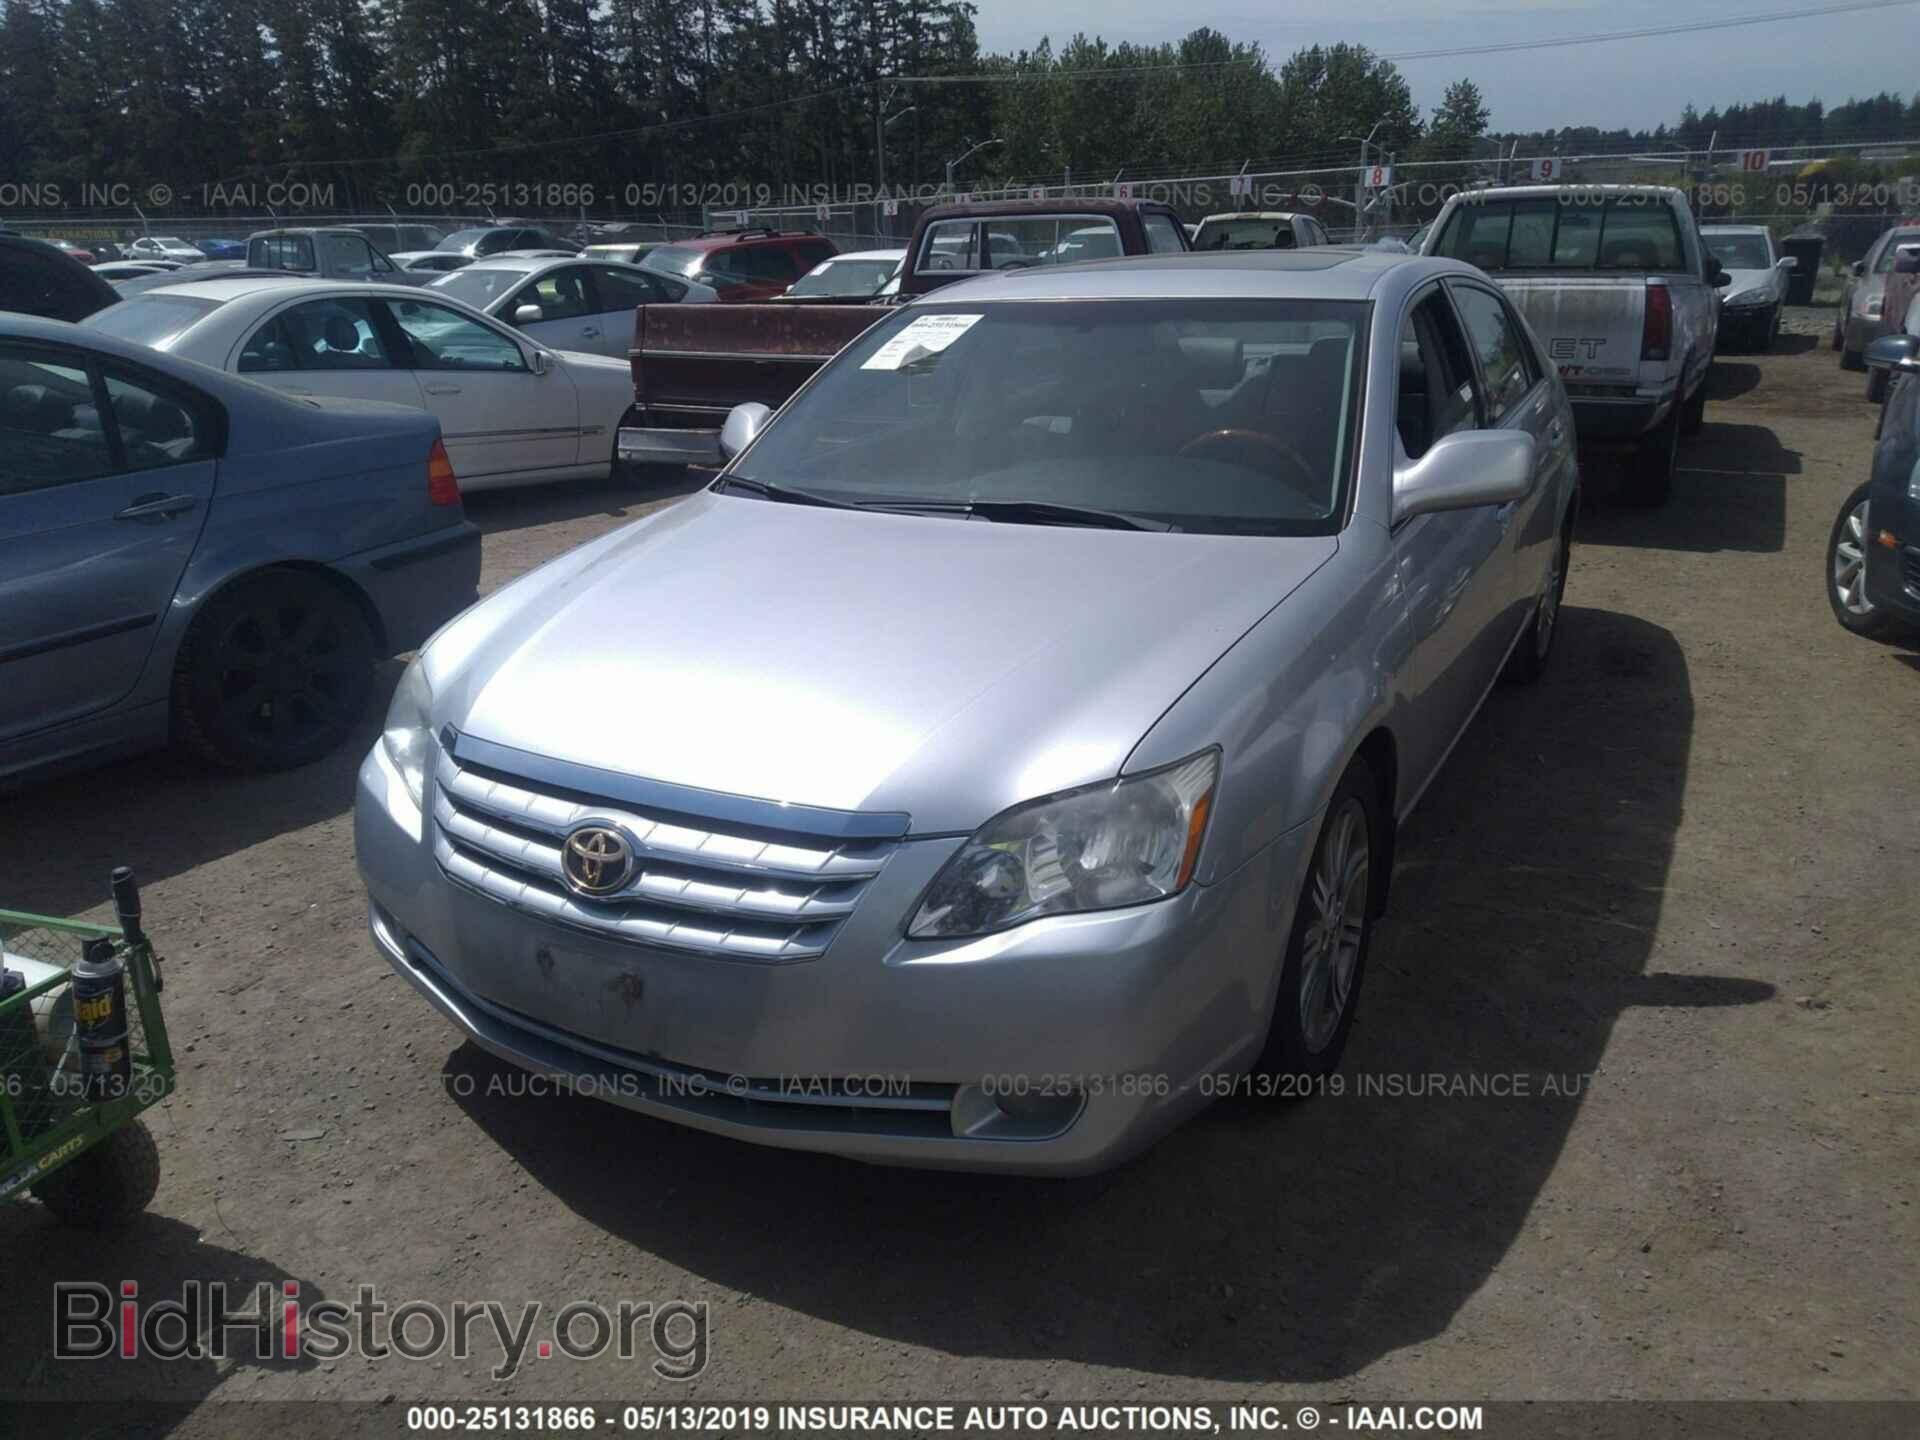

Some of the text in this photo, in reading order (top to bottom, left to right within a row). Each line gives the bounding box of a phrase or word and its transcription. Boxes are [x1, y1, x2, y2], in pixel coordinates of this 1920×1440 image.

[1541, 159, 1553, 177] 9
[1743, 151, 1764, 171] 10
[1373, 165, 1382, 186] 8
